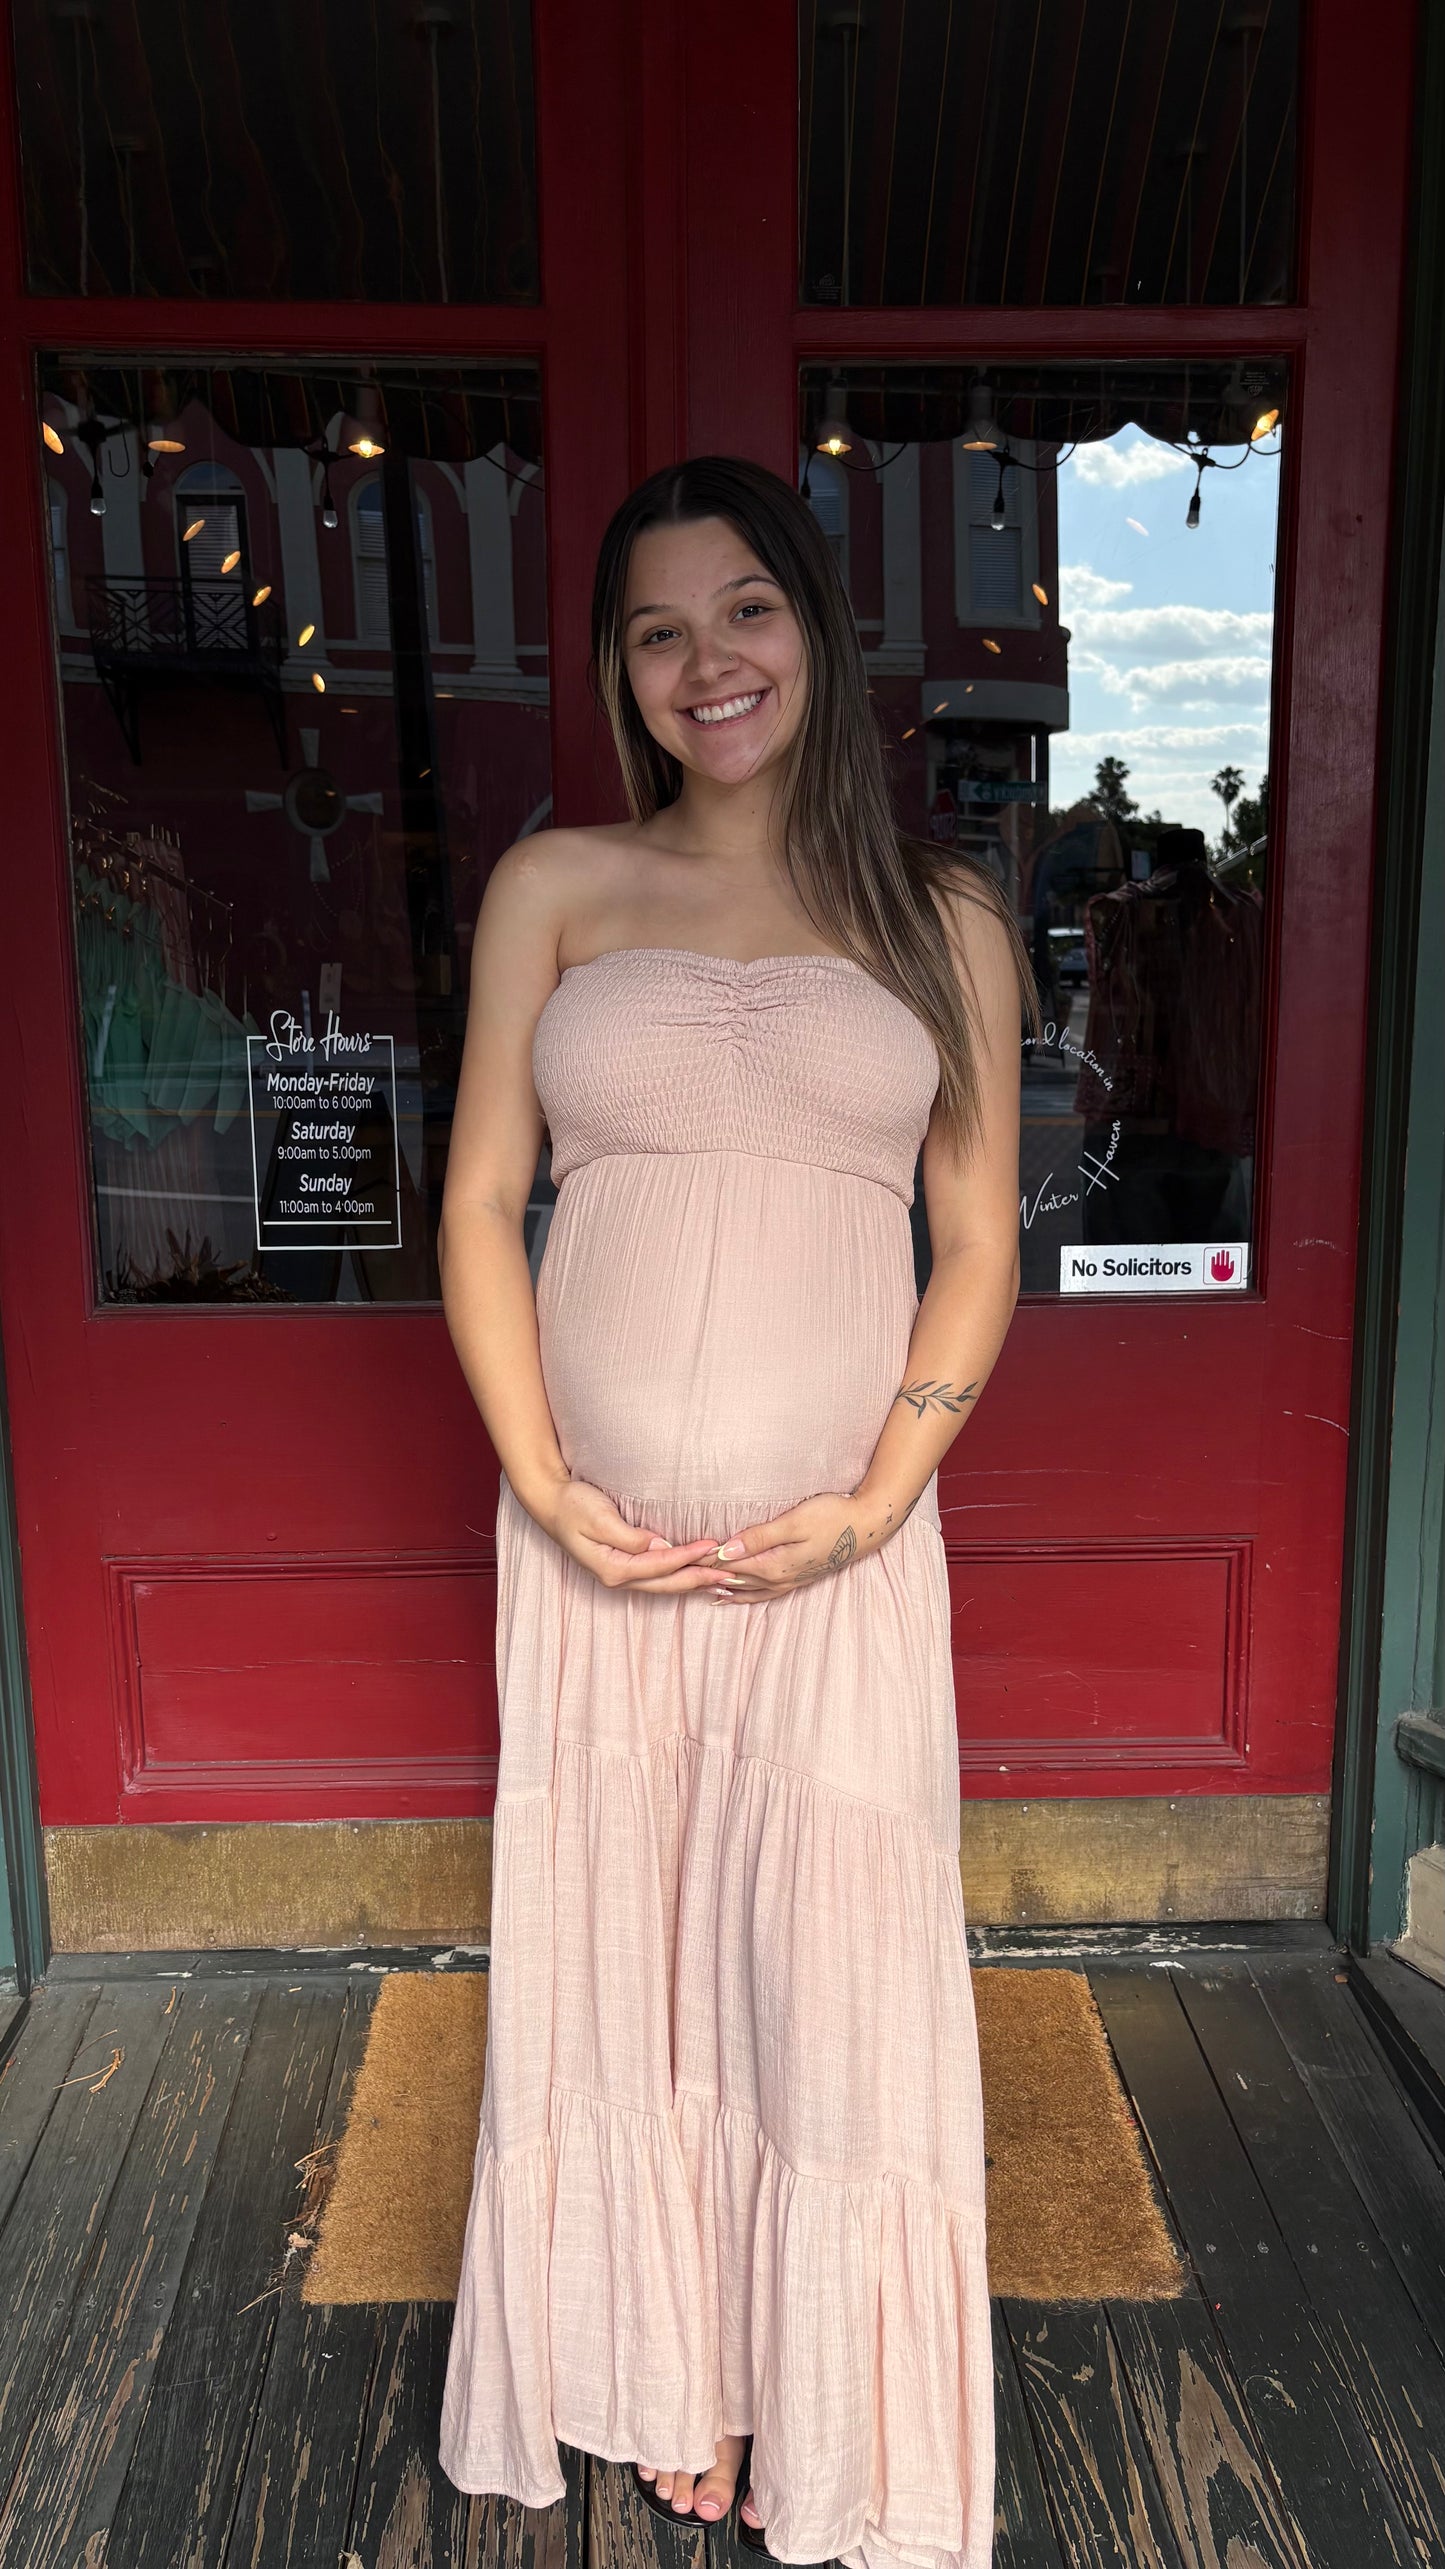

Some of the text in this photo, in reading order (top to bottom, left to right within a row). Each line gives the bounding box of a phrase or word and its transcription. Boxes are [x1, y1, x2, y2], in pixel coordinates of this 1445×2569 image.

[265, 1009, 372, 1062] Store Hours
[1058, 1026, 1105, 1078] location
[1103, 1075, 1114, 1092] in
[266, 1072, 375, 1095] Monday-Friday
[272, 1095, 373, 1112] 10:00am to 600pm
[291, 1120, 356, 1144] Saturday
[277, 1146, 318, 1160] 9:00am
[318, 1146, 330, 1160] to
[1077, 1119, 1121, 1196] Haven
[299, 1173, 353, 1196] Sunday
[279, 1200, 320, 1214] 11:00am
[321, 1200, 333, 1214] to
[1071, 1257, 1192, 1277] No Solicitors
